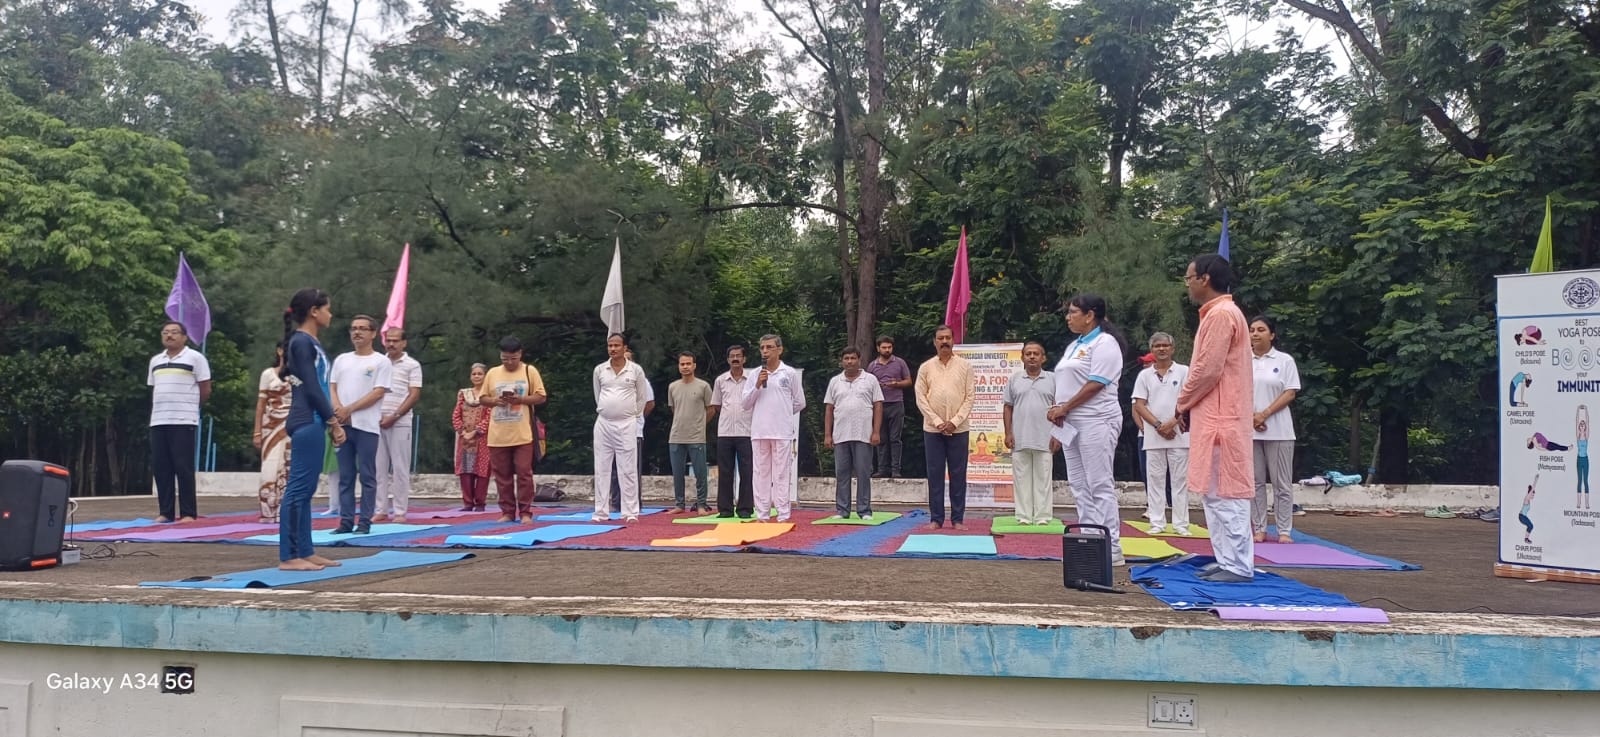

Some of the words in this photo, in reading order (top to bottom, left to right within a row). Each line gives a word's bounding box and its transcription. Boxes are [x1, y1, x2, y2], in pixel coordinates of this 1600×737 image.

[1557, 328, 1580, 337] YOGA
[1552, 346, 1600, 370] BOOS
[990, 376, 1008, 385] FOR
[1557, 380, 1600, 392] IMMUNIT
